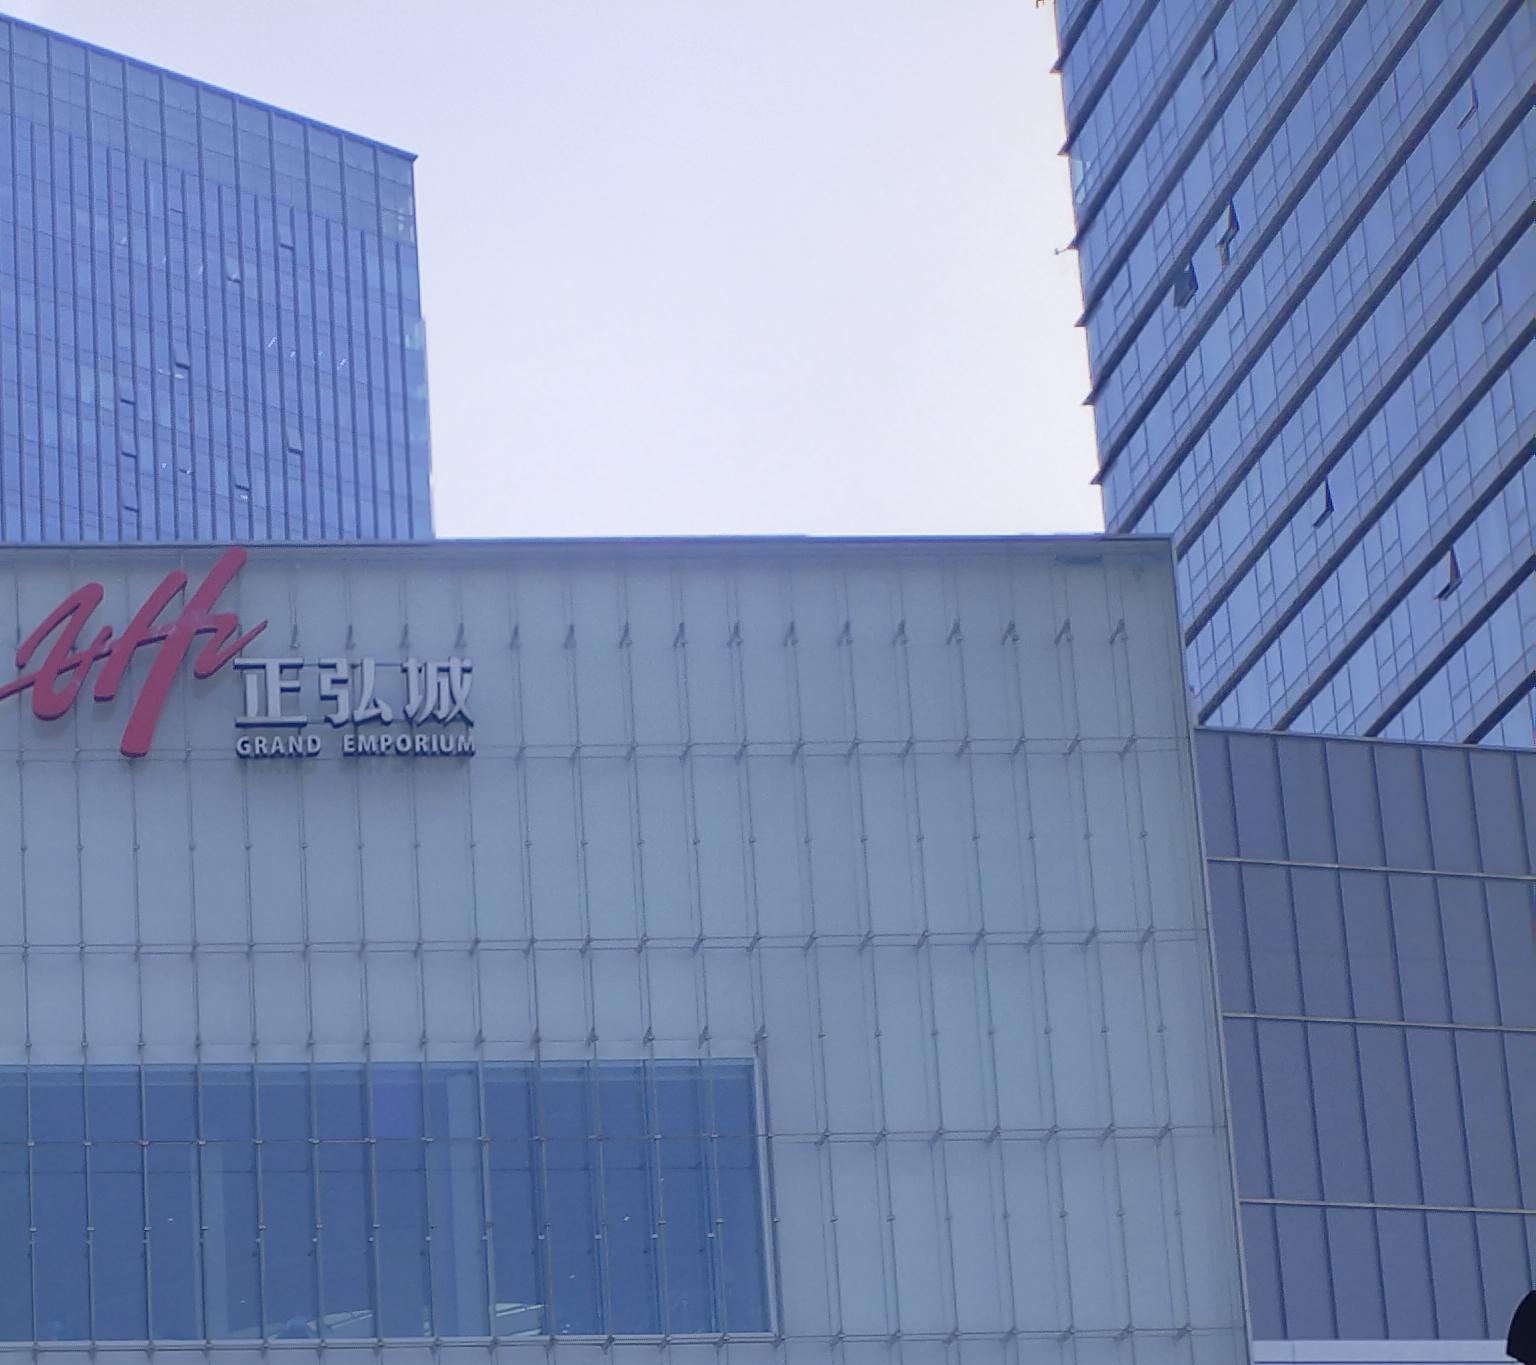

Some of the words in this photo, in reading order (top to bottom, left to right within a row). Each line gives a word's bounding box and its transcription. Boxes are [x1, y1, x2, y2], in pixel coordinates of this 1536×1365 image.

[233, 656, 474, 727] 正弘城
[236, 734, 322, 758] GRAND
[343, 733, 476, 758] EMPORIUM
